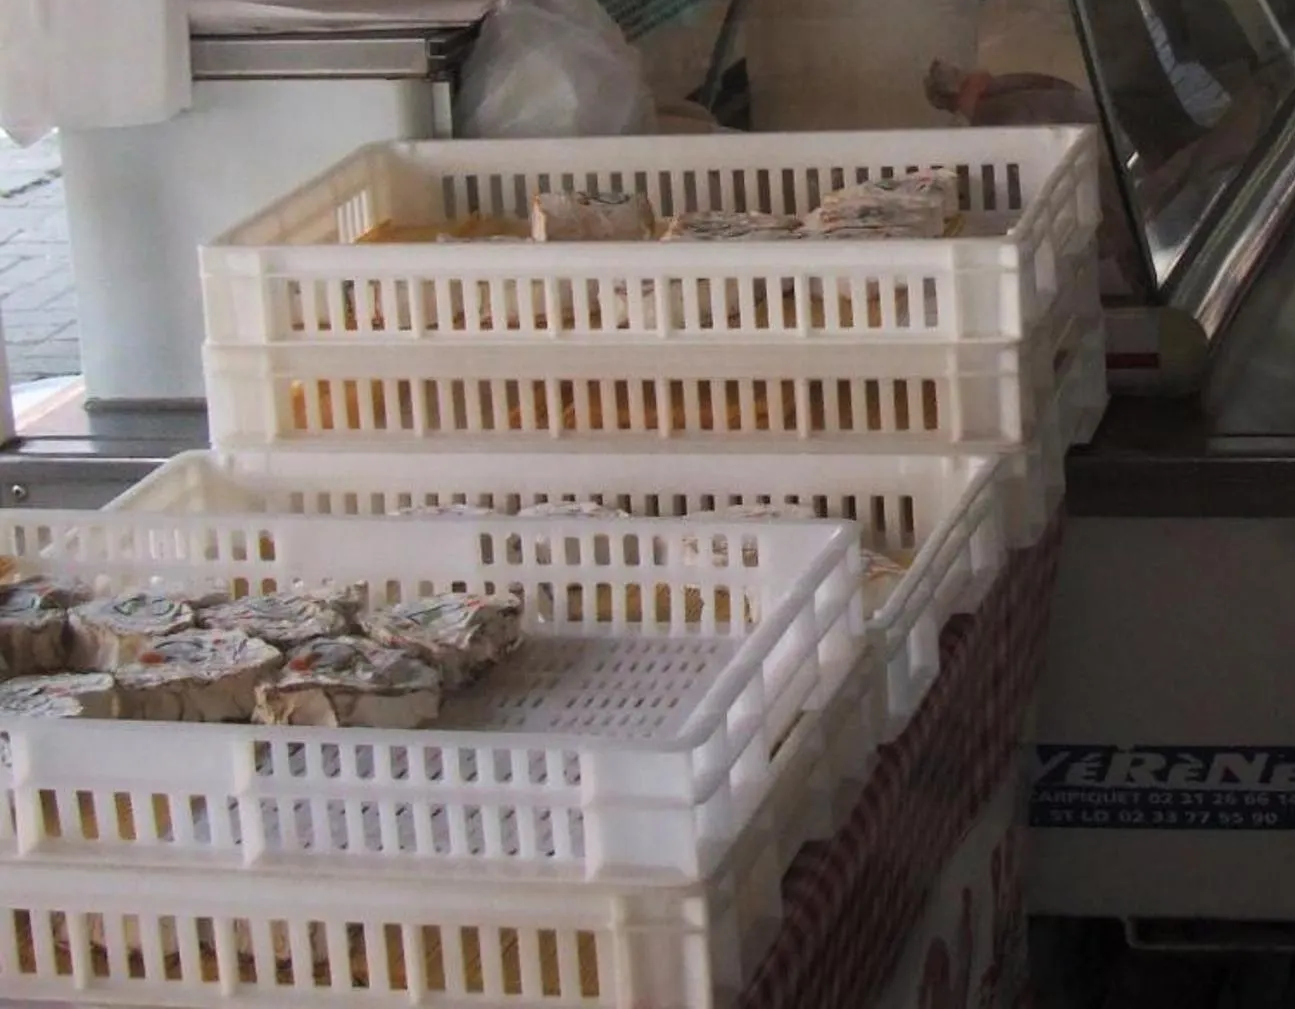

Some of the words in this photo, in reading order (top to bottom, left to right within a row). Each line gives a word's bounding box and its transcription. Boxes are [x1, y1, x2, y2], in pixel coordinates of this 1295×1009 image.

[1031, 791, 1141, 805] ARPIQUET
[1147, 791, 1175, 805] 02
[1118, 809, 1146, 824] 02
[1184, 811, 1211, 826] 77
